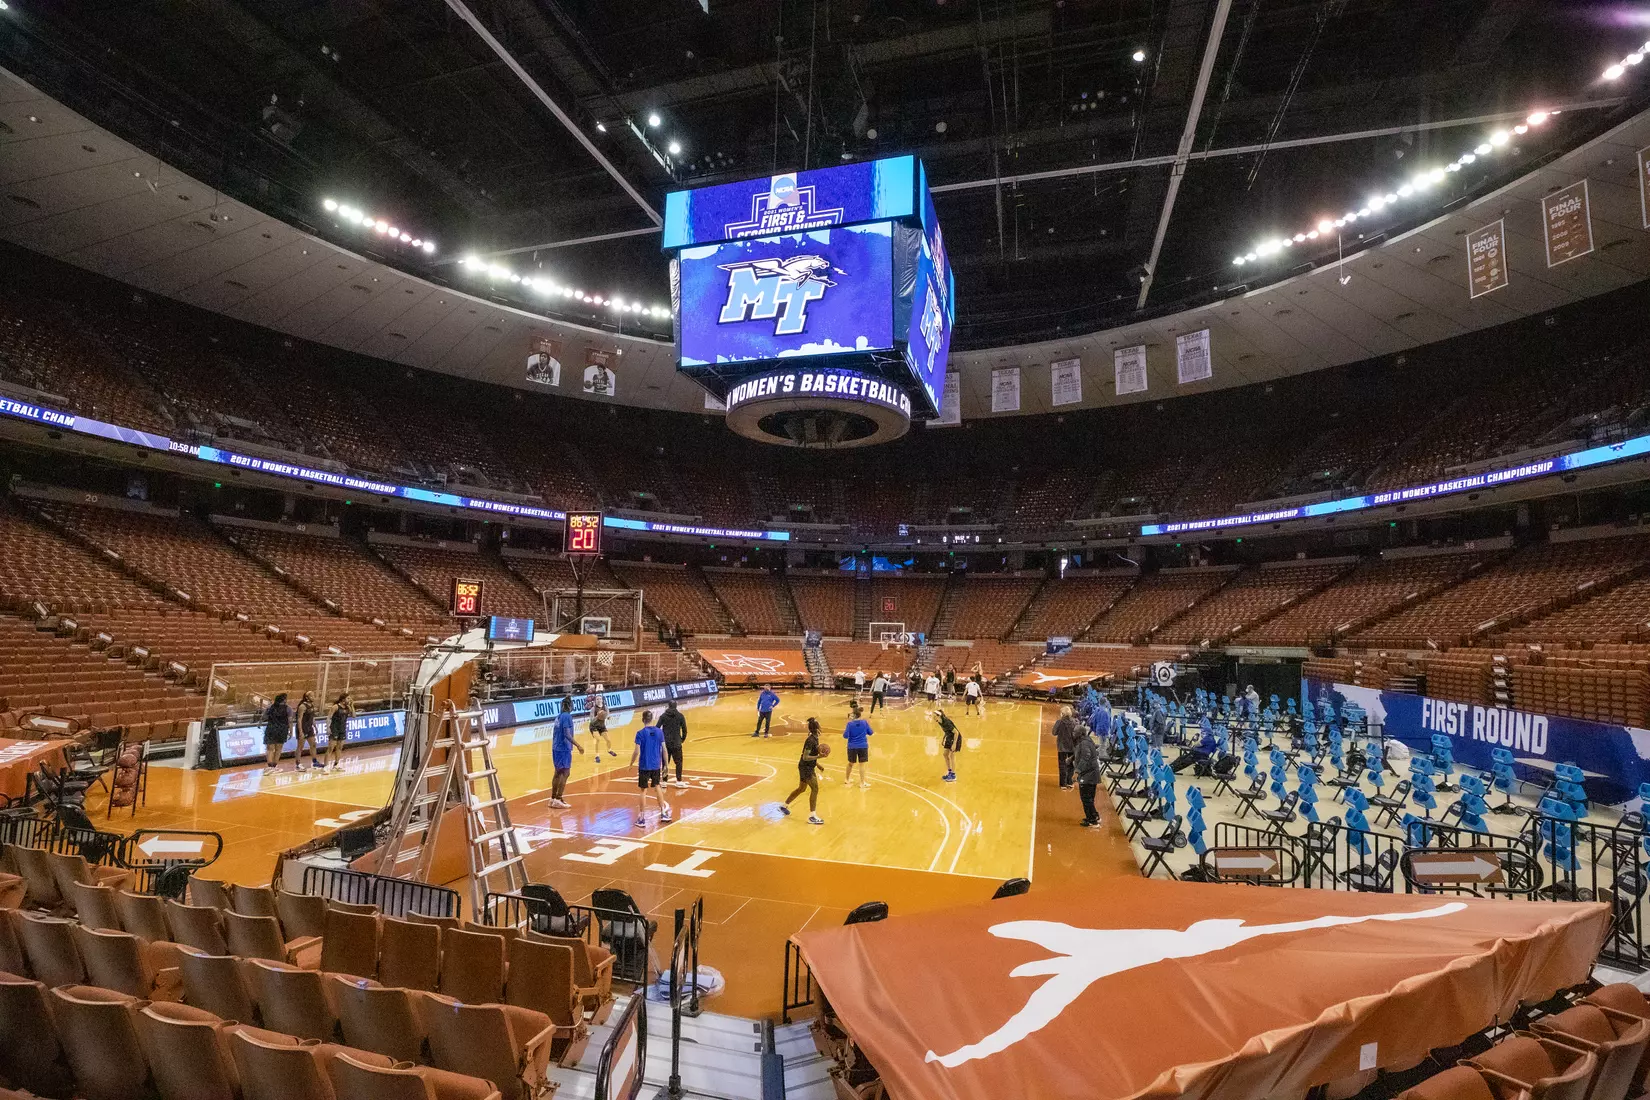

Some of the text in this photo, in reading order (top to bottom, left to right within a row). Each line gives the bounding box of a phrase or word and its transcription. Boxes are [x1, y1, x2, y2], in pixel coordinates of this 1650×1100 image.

[1550, 196, 1582, 214] FINAL
[1551, 202, 1581, 220] FOUR
[761, 210, 806, 228] FIRST &
[1472, 234, 1498, 249] FINAL
[1474, 240, 1498, 255] FOUR
[732, 374, 794, 405] WOMEN'S
[800, 374, 897, 405] BASKETBALL
[0, 400, 76, 426] ETBALL CHAM
[169, 440, 200, 455] 10:58 AM
[230, 455, 396, 493] 2021 DI WOMEN'S BASKETBALL CHAMPIONSHIP
[1374, 462, 1553, 503] 2021 DI WOMEN'S BASKETBALL CHAMPIONSHIP
[86, 494, 98, 502] 20
[493, 503, 520, 513] WOMEN'S
[520, 507, 553, 518] BASKETBALL
[1166, 522, 1180, 531] 2021
[1188, 520, 1216, 529] WOMEN'S
[1216, 516, 1252, 526] BASKETBALL
[1252, 509, 1298, 522] CHAMPIONSHIP
[572, 529, 594, 549] 20
[672, 525, 694, 533] WOMEN'S
[696, 528, 725, 536] BASKETBALL
[725, 530, 763, 538] CHAMPIONSHIP
[458, 584, 478, 596] 86:52
[460, 596, 474, 610] 20
[644, 689, 666, 700] #NCAAW
[534, 702, 554, 717] JOIN
[368, 716, 389, 726] FOUR
[1422, 698, 1548, 756] FIRST ROUND
[355, 731, 360, 739] 4
[226, 740, 240, 748] FINAL
